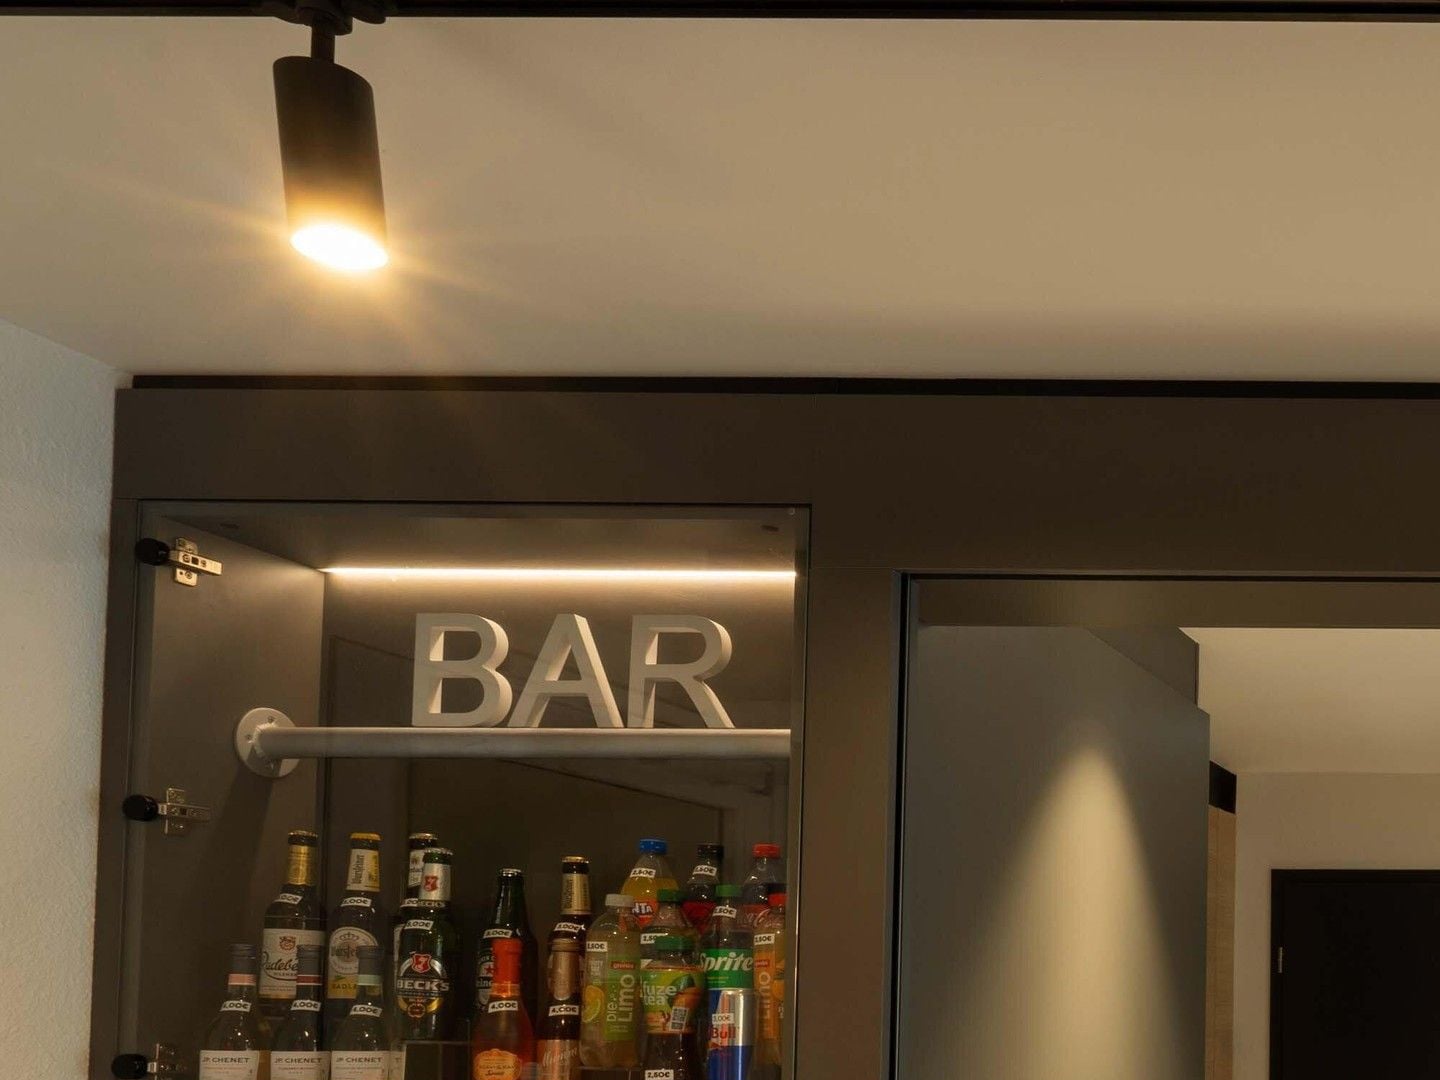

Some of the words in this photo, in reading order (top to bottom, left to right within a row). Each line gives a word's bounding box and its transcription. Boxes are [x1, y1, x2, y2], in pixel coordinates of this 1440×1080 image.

[411, 612, 736, 729] BAR
[699, 951, 753, 972] Sprite
[643, 995, 666, 1007] tea
